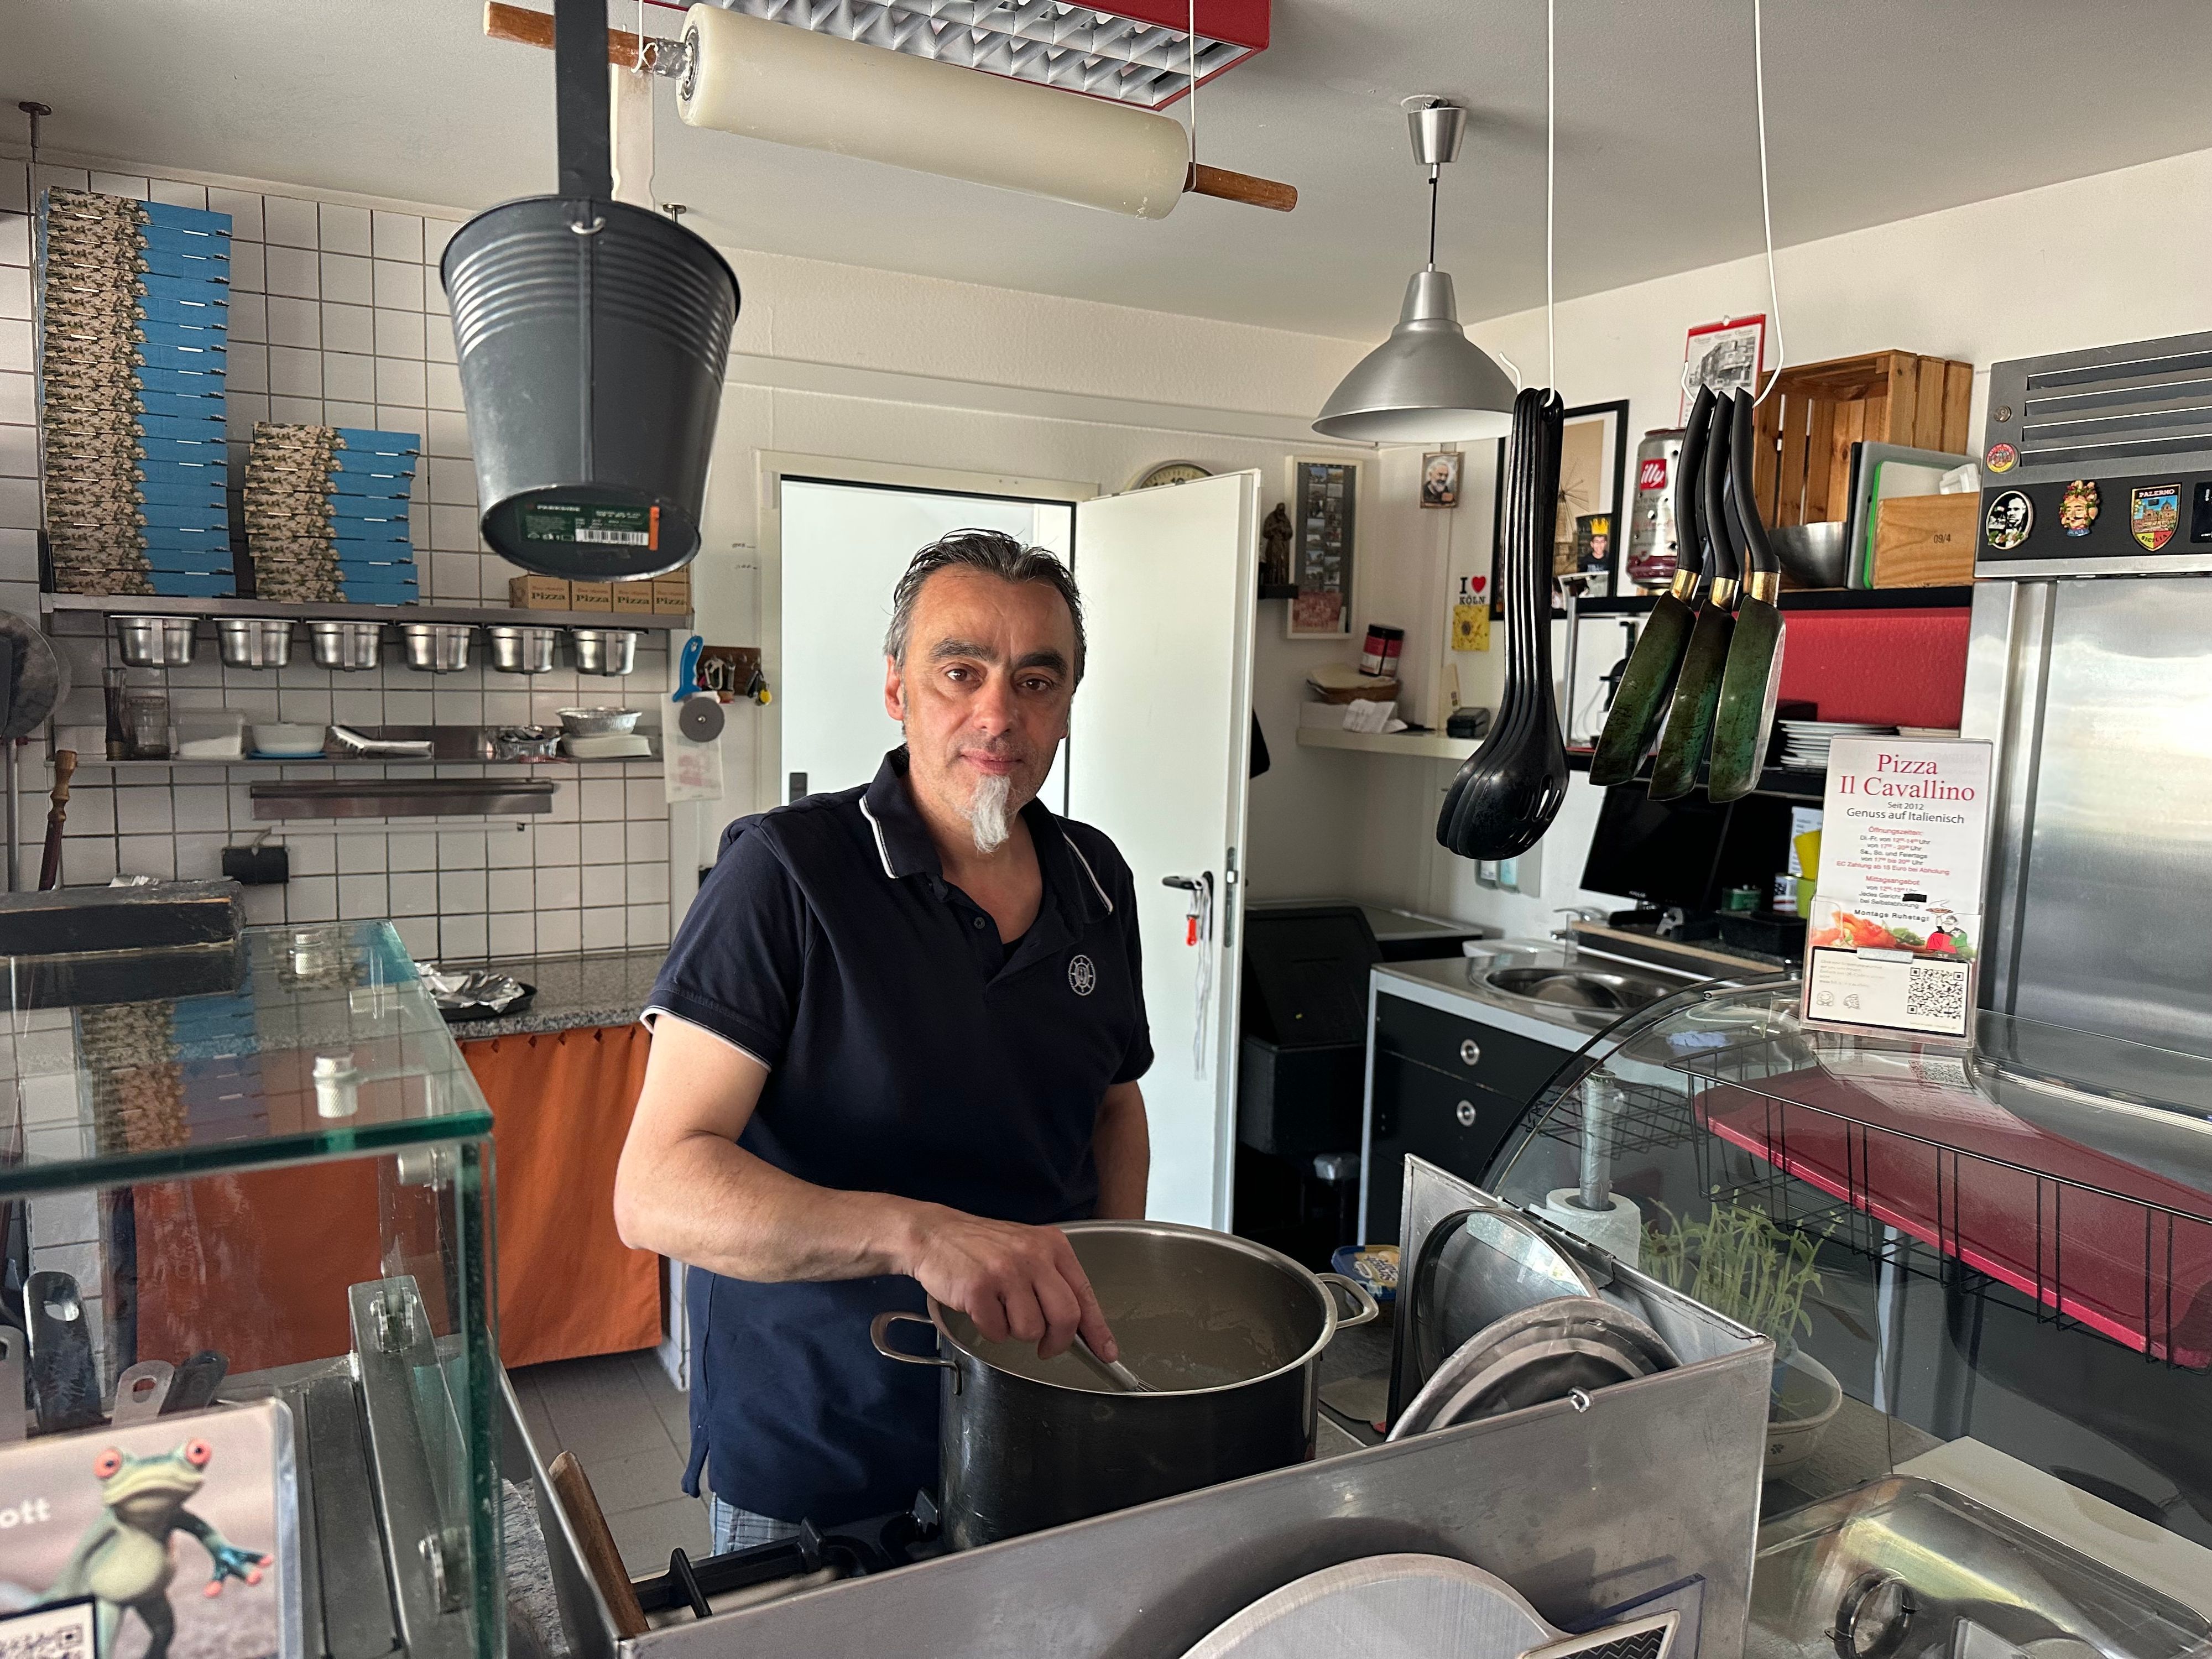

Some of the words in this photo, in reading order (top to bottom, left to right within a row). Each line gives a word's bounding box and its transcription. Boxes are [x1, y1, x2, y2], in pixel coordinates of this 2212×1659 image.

[1641, 463, 1665, 487] illy
[2139, 489, 2175, 498] PALERMO
[1933, 534, 1951, 544] 09/4
[1460, 577, 1468, 593] I
[531, 592, 565, 601] Pizza
[576, 594, 609, 603] Pizza
[618, 596, 650, 604] Pizza
[1459, 595, 1486, 605] KÖLN
[1876, 754, 1938, 775] Pizza
[1839, 775, 1855, 794] Il
[1864, 777, 1975, 801] Cavallino
[1846, 808, 1886, 818] Genuss
[1888, 811, 1906, 820] auf
[1908, 812, 1964, 824] Italienisch
[1866, 876, 1920, 885] Mittagsangebot
[1871, 899, 1919, 909] Selbstabholung
[1854, 910, 1889, 919] Montags
